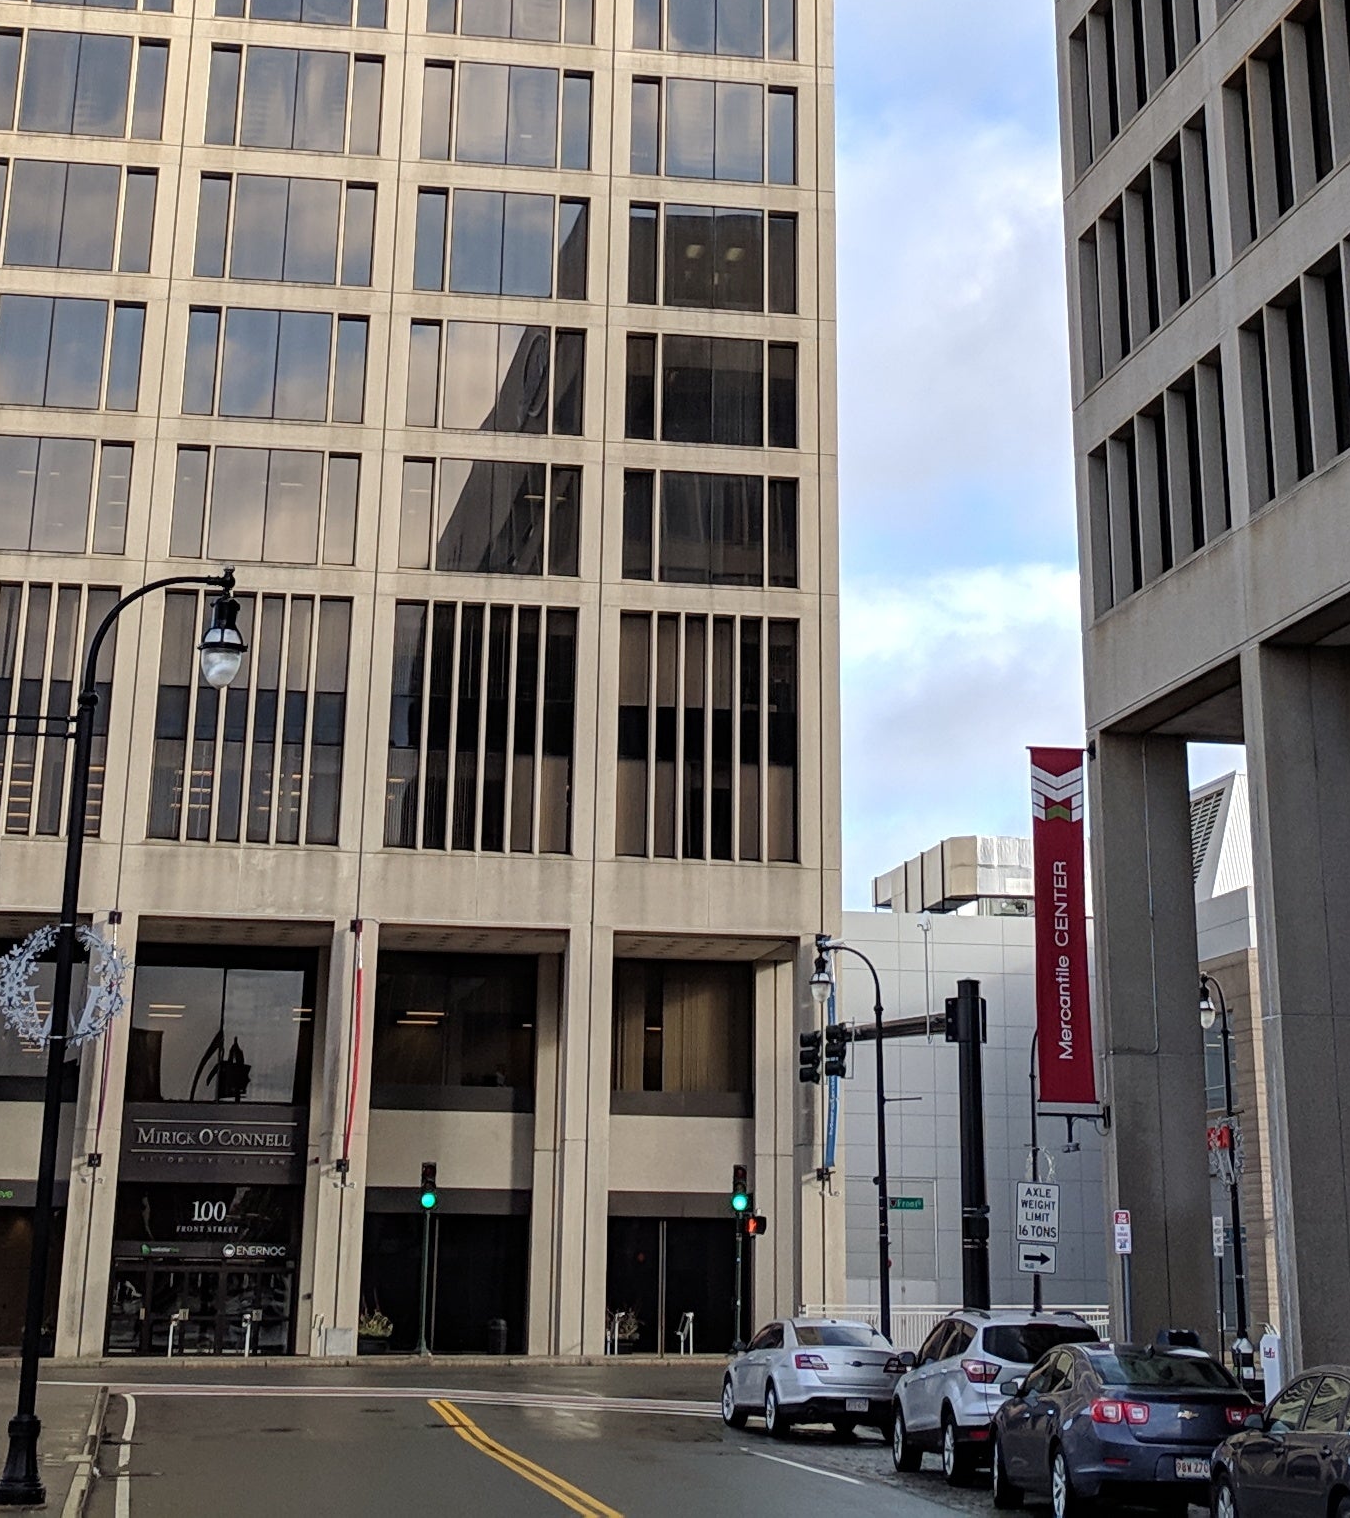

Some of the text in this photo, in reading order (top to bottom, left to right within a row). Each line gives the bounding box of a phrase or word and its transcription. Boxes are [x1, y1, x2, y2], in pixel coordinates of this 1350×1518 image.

[1054, 861, 1073, 1060] Mercantile CENTER
[137, 1127, 291, 1147] MIRICK O'CONNELL
[1025, 1187, 1052, 1198] AXLE
[191, 1200, 227, 1222] 100
[1020, 1199, 1056, 1211] WEIGHT
[1025, 1212, 1050, 1222] LIMIT
[176, 1225, 239, 1233] FRONT STREET
[1018, 1225, 1057, 1238] 16 TONS
[236, 1246, 286, 1256] ENERNOC
